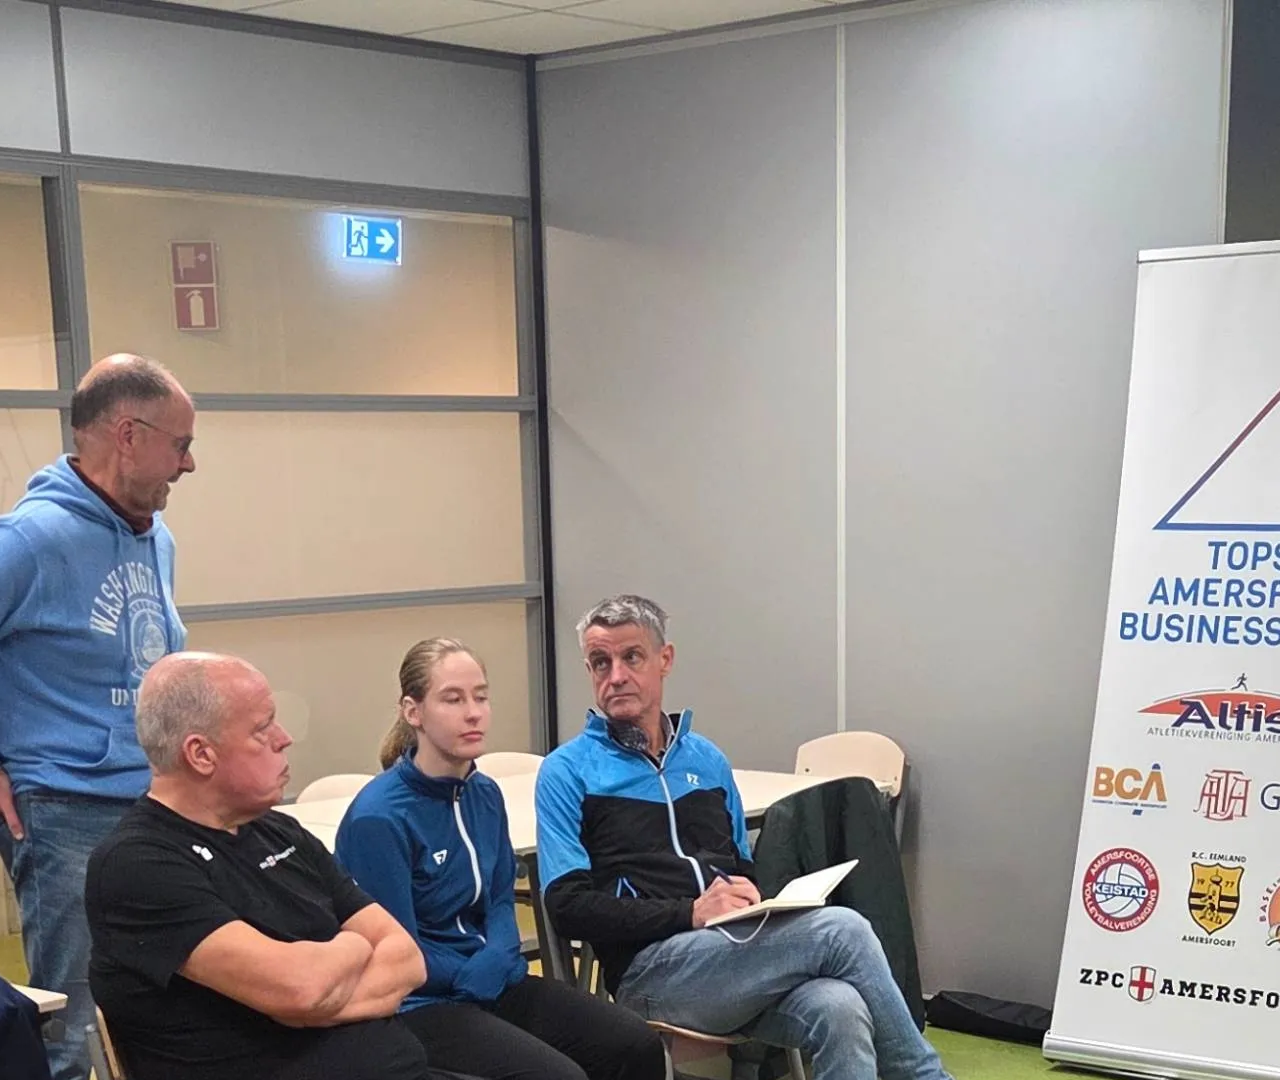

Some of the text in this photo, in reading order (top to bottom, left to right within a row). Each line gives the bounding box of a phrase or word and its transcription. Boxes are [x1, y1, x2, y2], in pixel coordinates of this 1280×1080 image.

[90, 561, 161, 636] WASHINGT
[1147, 727, 1252, 743] ATLETIEKVERENIGING
[1092, 763, 1168, 802] BCA
[1090, 849, 1157, 881] AMERSFOORTSE
[1208, 852, 1247, 863] EEMLAND
[1093, 882, 1149, 899] KEISTAD
[1181, 935, 1236, 947] AMERSFOORT
[1079, 968, 1125, 989] ZPC
